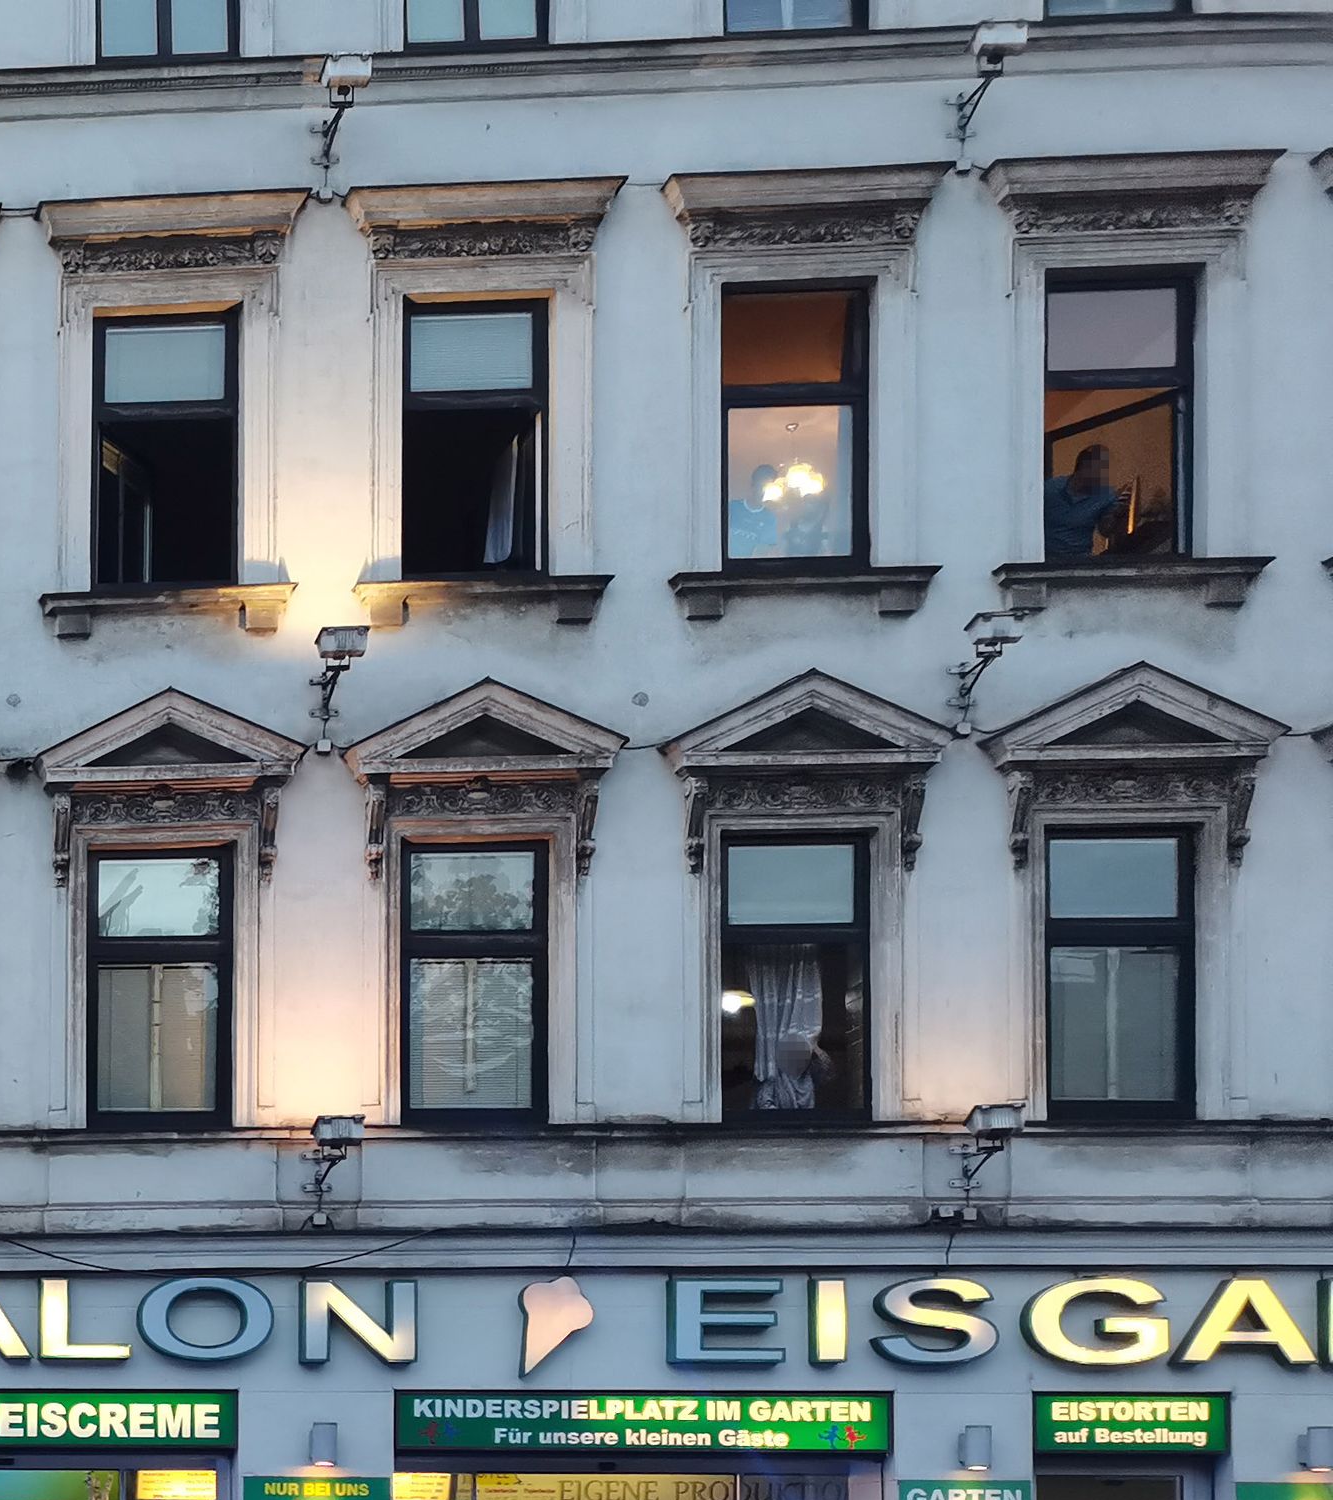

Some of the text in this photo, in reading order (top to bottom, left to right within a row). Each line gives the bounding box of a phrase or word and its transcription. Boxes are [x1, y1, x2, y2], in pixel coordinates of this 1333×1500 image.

[413, 1398, 872, 1422] KINDERSPIELPLATZ IM GARTEN
[1051, 1400, 1210, 1421] EISTORTEN
[493, 1426, 790, 1447] Für unsere kleinen Gäste
[1054, 1428, 1208, 1447] auf Bestellung
[264, 1482, 369, 1496] NUR BEI UNS
